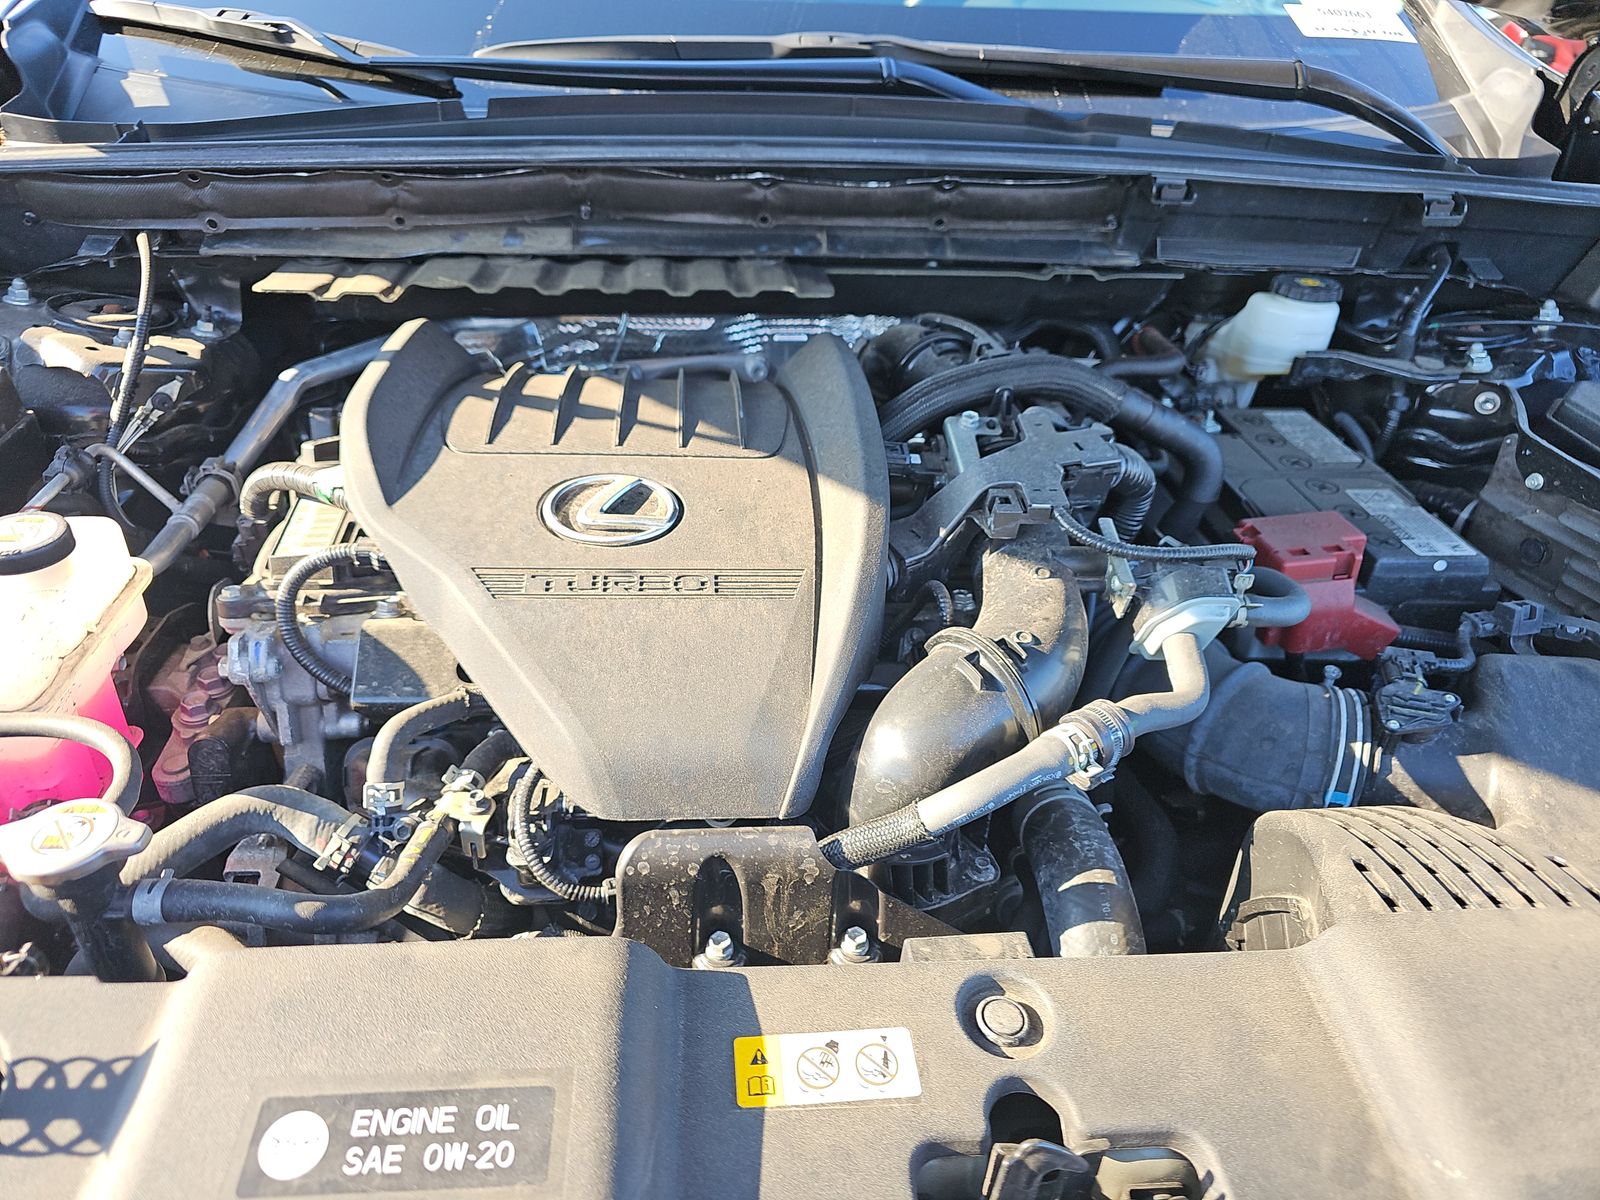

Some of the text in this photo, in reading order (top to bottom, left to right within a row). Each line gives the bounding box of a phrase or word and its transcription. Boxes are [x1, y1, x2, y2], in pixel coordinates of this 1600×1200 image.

[529, 573, 711, 594] TURBO
[349, 1102, 520, 1138] ENGINE OIL
[341, 1139, 516, 1176] SAE 0W-20
